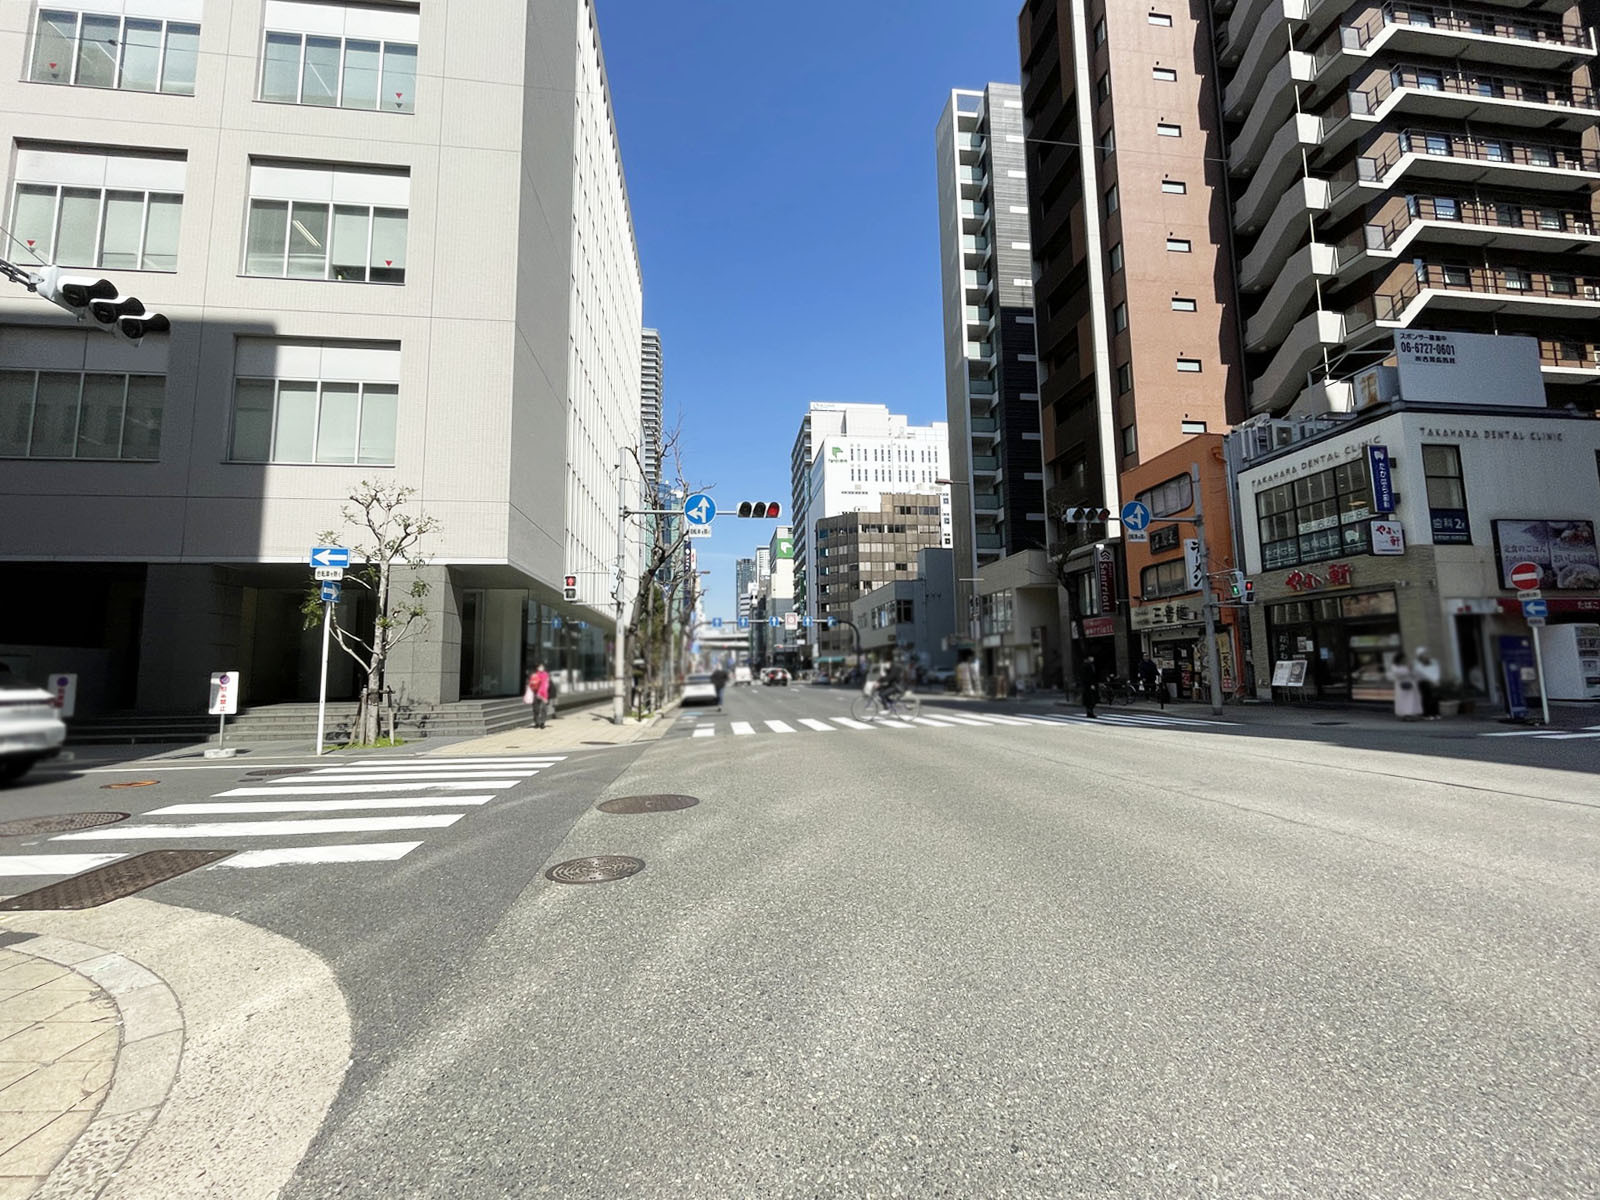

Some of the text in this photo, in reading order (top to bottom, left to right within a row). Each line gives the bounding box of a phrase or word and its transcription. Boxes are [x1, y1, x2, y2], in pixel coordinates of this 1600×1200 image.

[1401, 342, 1455, 355] 06-6727-0601
[1420, 427, 1563, 442] TAKAHARA DENTAL CLINIC
[1252, 435, 1381, 486] TAKAHARA DENTAL CLINIC
[1191, 541, 1202, 587] ラーメン
[1285, 564, 1352, 592] やよい軒
